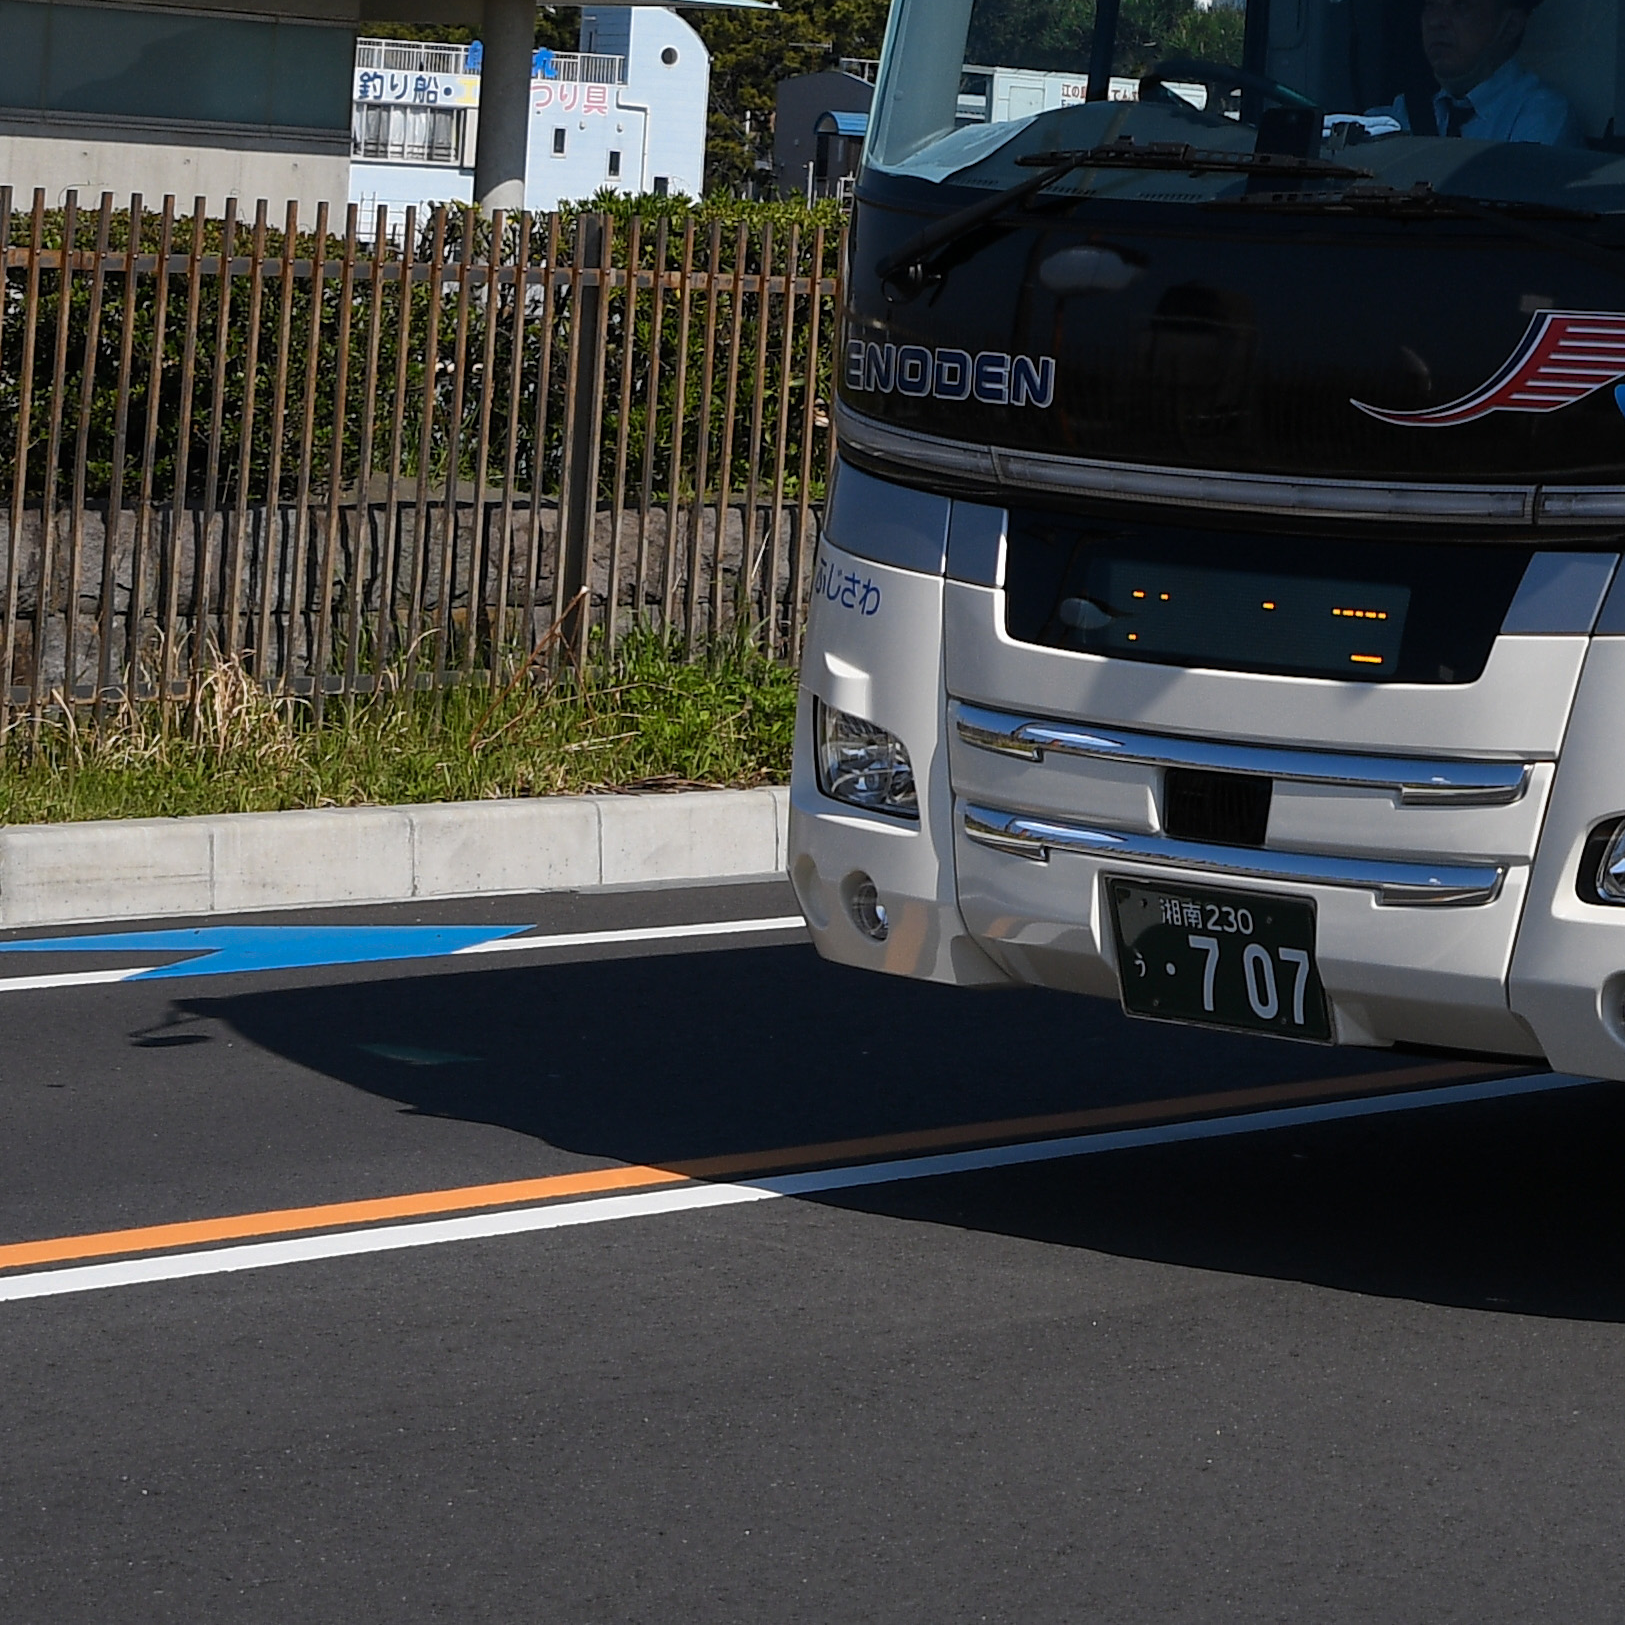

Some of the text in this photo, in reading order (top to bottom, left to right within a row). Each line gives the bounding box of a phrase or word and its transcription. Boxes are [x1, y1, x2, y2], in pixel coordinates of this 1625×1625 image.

[845, 339, 1056, 408] ENODEN
[815, 556, 882, 617] ふじさわ
